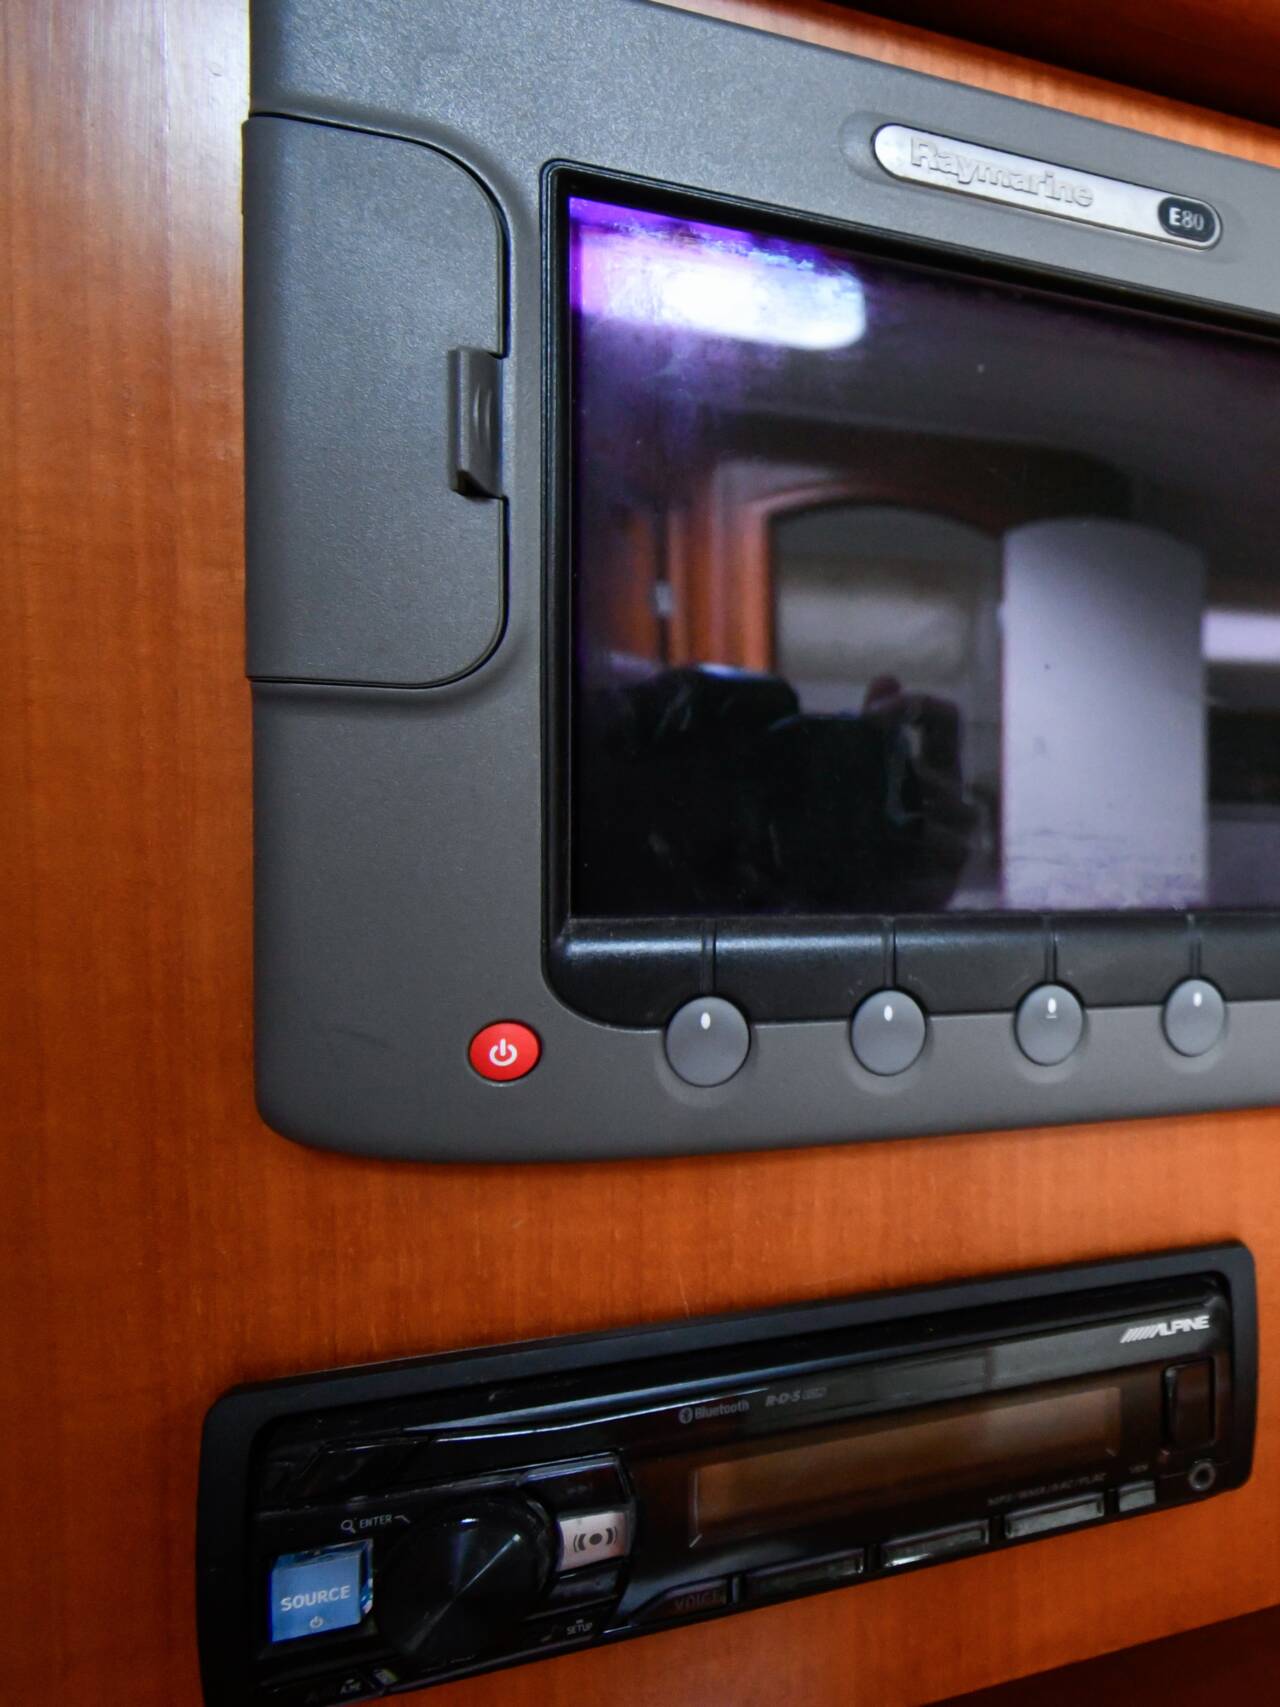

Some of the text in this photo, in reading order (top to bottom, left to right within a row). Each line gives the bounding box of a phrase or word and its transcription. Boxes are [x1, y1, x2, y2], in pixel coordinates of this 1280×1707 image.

[910, 136, 1205, 232] Raymarine E80
[1120, 1314, 1210, 1343] ALPINE
[694, 1400, 750, 1419] Bluetooth
[359, 1514, 393, 1529] ENTER
[280, 1584, 351, 1612] SOURCE
